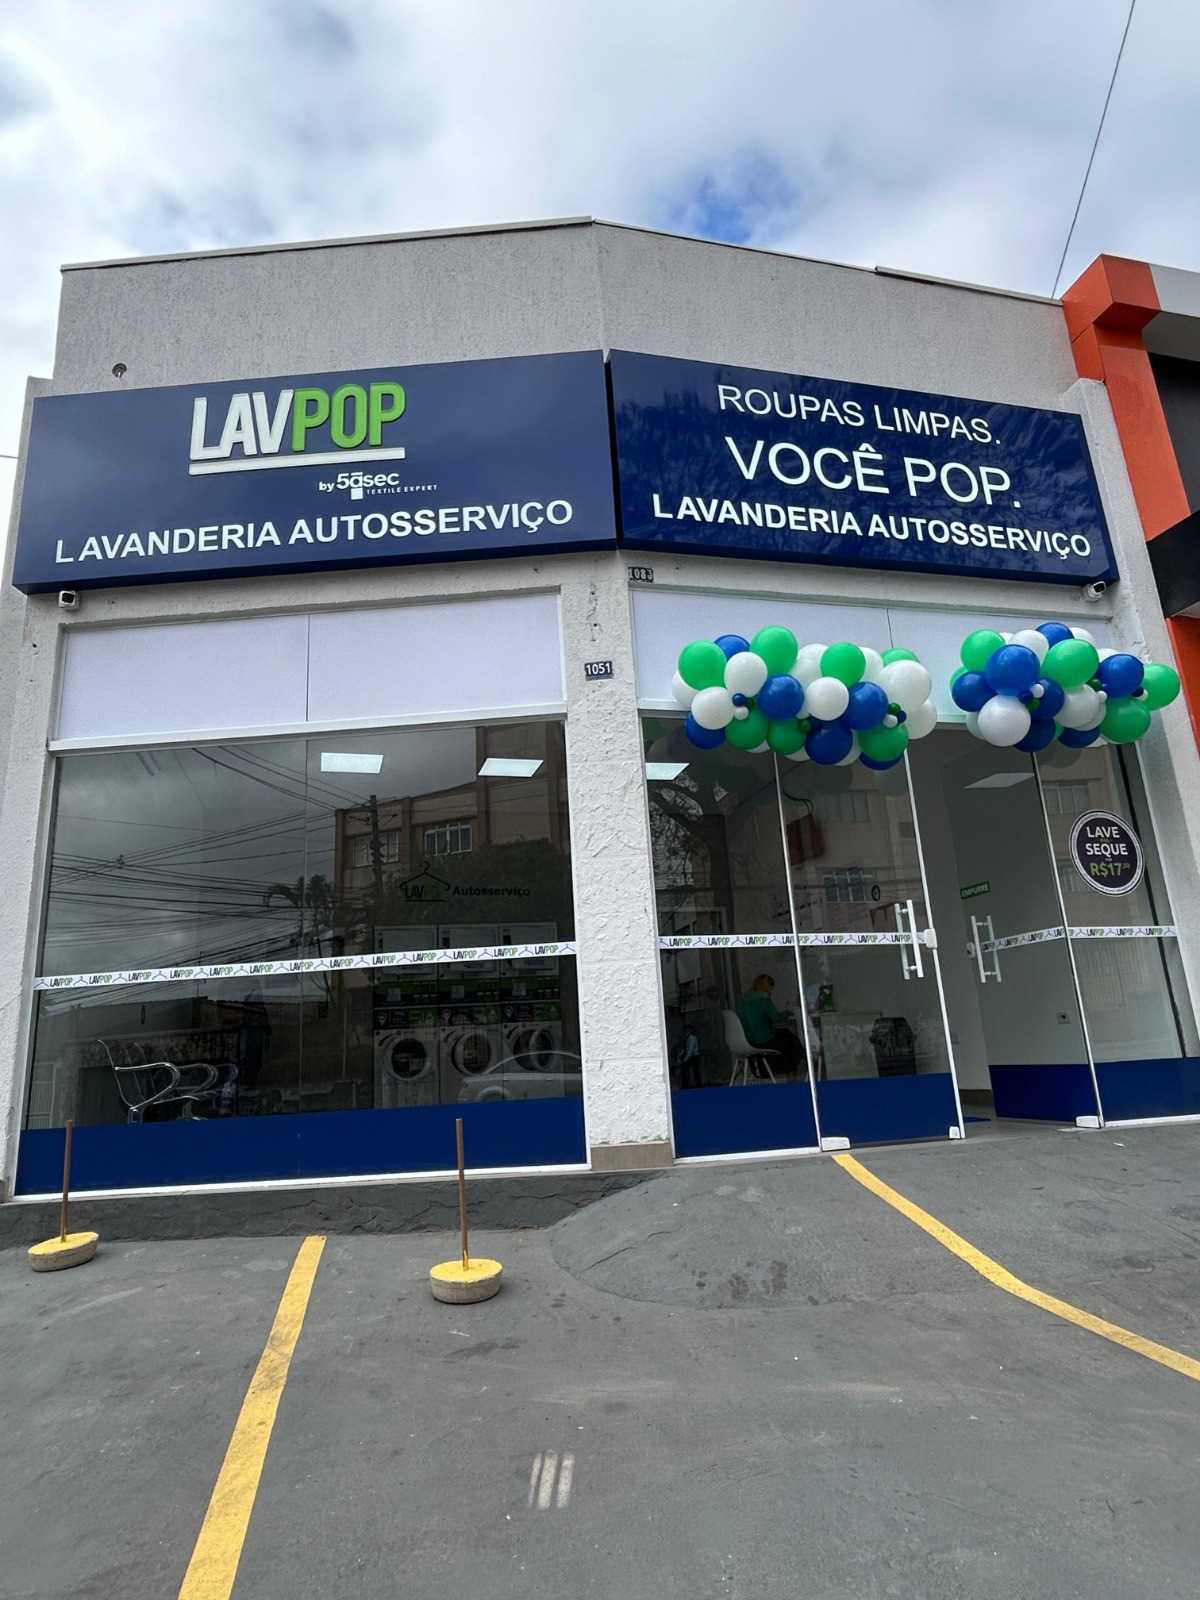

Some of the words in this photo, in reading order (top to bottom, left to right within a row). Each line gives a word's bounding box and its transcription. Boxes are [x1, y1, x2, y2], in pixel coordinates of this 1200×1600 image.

[189, 382, 405, 461] LAVPOP
[717, 384, 865, 428] ROUPAS
[875, 405, 1001, 445] LIMPAS.
[318, 481, 335, 492] by
[725, 436, 890, 494] VOCÊ
[904, 456, 1021, 508] POP.
[55, 520, 281, 564] LAVANDERIA
[288, 499, 574, 544] AUTOSSERVIÇO
[651, 493, 863, 537] LAVANDERIA
[868, 513, 1091, 560] AUTOSSERVIÇO
[586, 662, 612, 676] 1051
[1085, 843, 1129, 857] SEQUE
[1086, 826, 1121, 838] LAVE
[50, 977, 73, 988] LAVPOP
[88, 974, 113, 985] LAVPOP
[127, 972, 152, 982] LAVPOP
[169, 969, 194, 979] LAVPOP
[209, 967, 233, 977] LAVPOP
[250, 964, 274, 974] LAVPOP
[290, 962, 314, 972] LAVPOP
[330, 959, 354, 969] LAVPOP
[372, 955, 397, 966] LAVPOP
[412, 952, 437, 962] LAVPOP
[453, 950, 478, 960] LAVPOP
[493, 947, 518, 957] LAVPOP
[534, 944, 559, 955] LAVPOP
